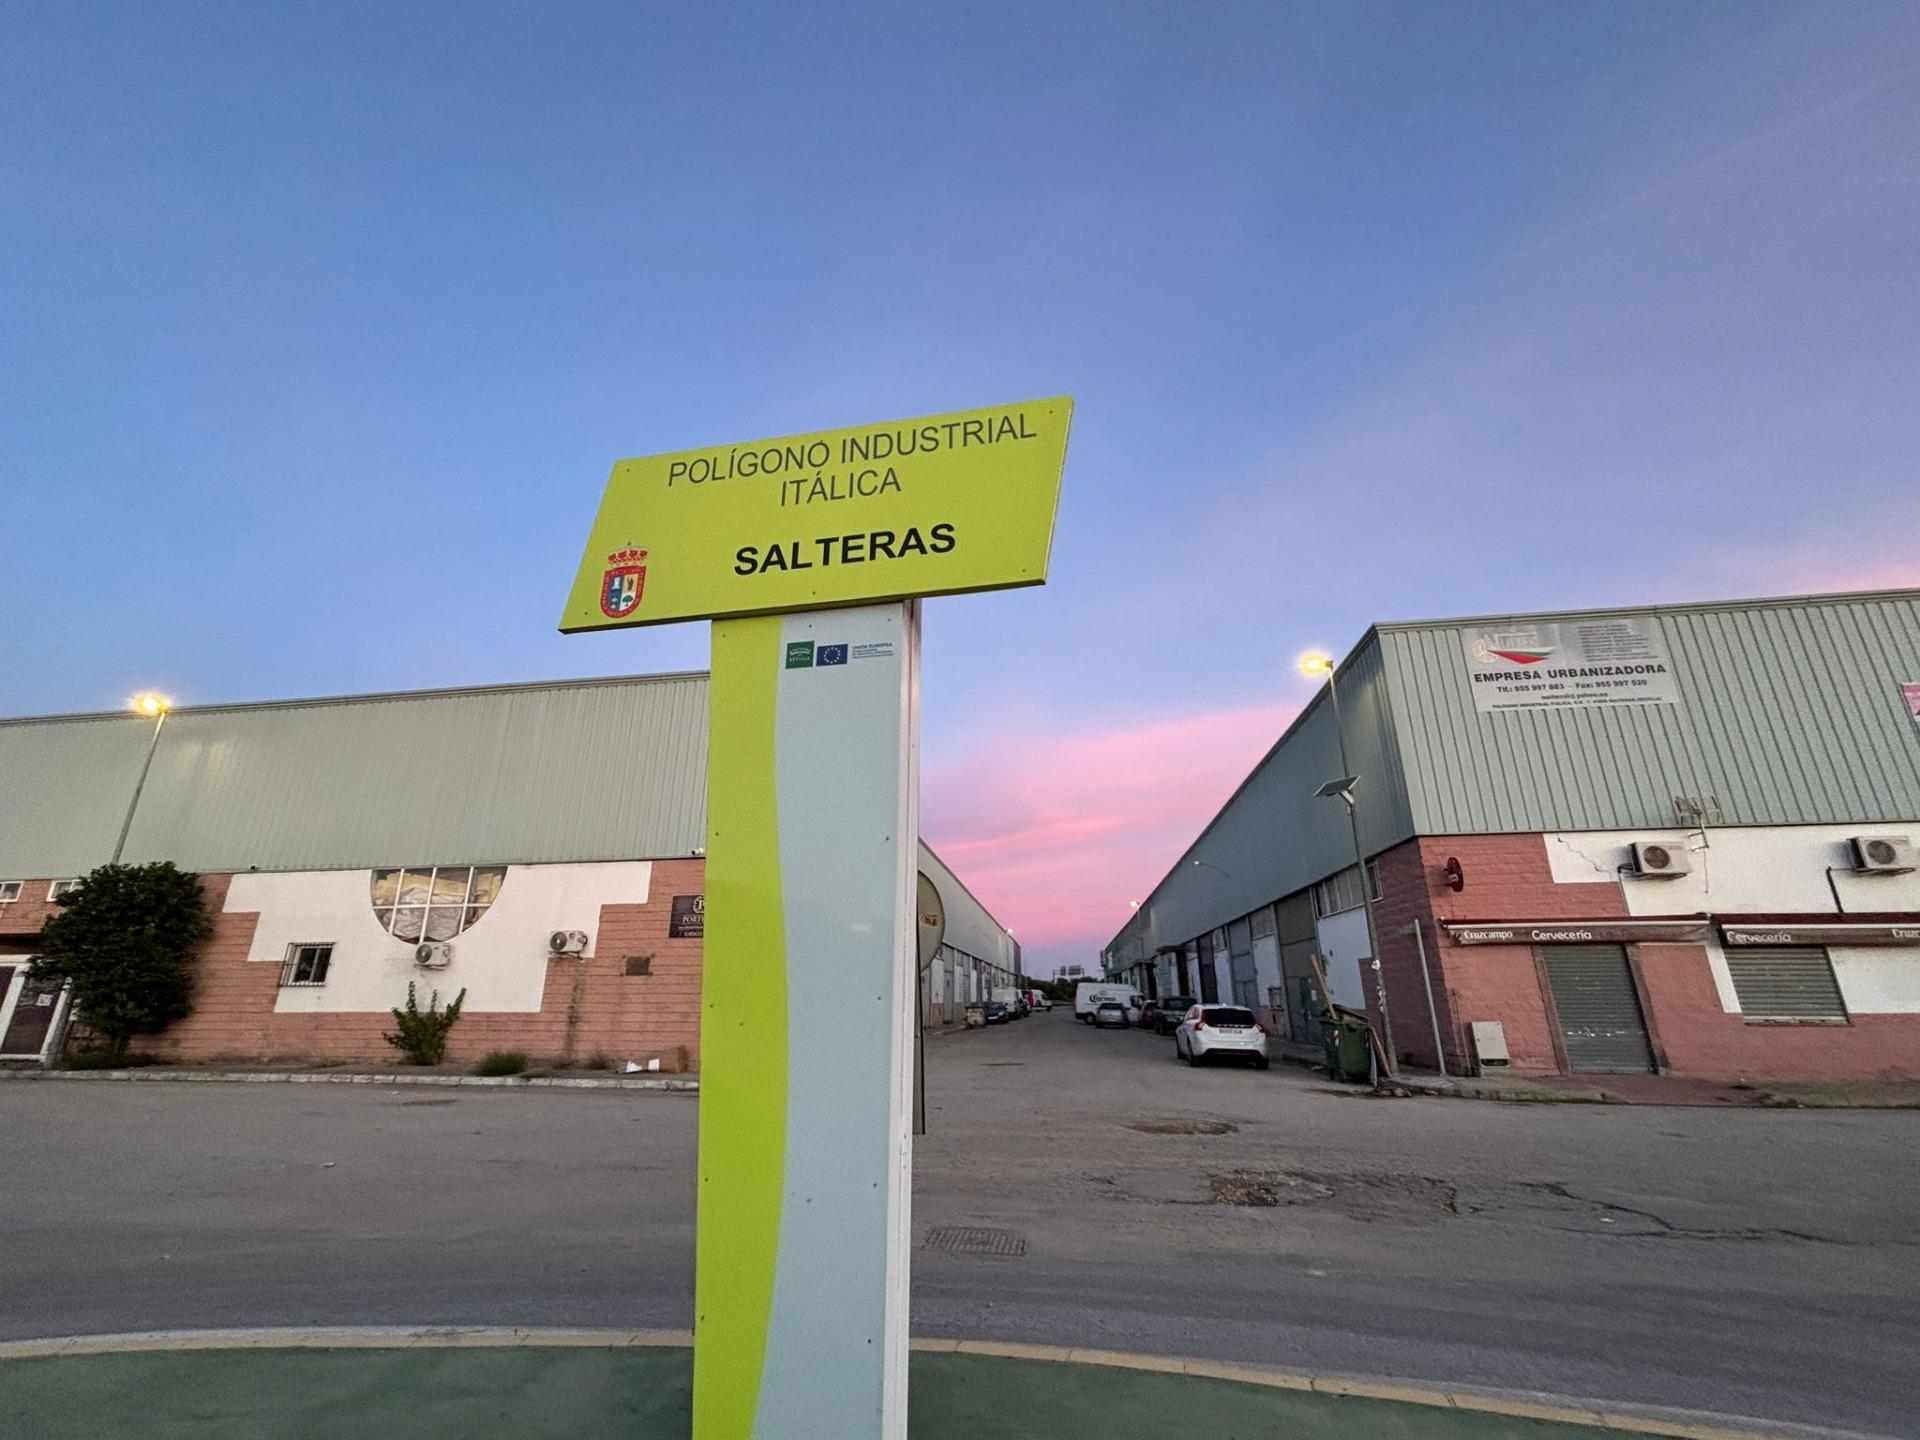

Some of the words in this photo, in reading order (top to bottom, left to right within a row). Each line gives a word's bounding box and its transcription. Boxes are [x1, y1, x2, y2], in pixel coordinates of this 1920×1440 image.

[668, 441, 830, 487] POLÍGONO
[840, 413, 1037, 464] INDUSTRIAL
[781, 466, 901, 507] ITÁLICA
[734, 523, 956, 576] SALTERAS
[1474, 670, 1541, 683] EMPRESA
[1547, 664, 1667, 680] URBANIZADORA
[1463, 930, 1513, 940] Cruzcampo
[1531, 929, 1592, 940] Cervecería
[1726, 931, 1792, 944] Cervecería
